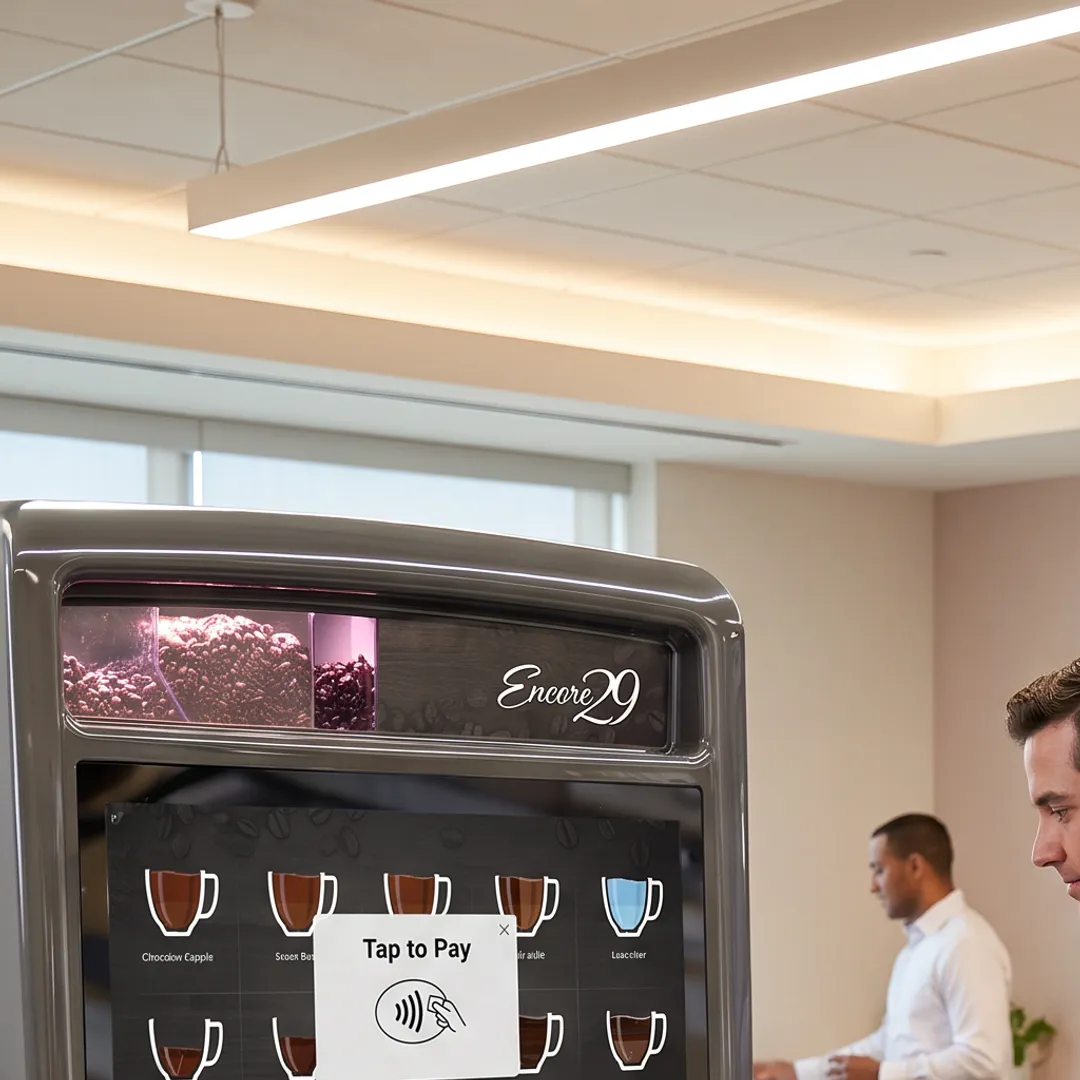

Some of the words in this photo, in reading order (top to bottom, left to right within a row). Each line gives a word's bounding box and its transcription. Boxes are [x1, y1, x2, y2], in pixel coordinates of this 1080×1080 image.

[362, 938, 401, 964] Tap
[406, 940, 428, 959] to
[434, 937, 472, 963] Pay
